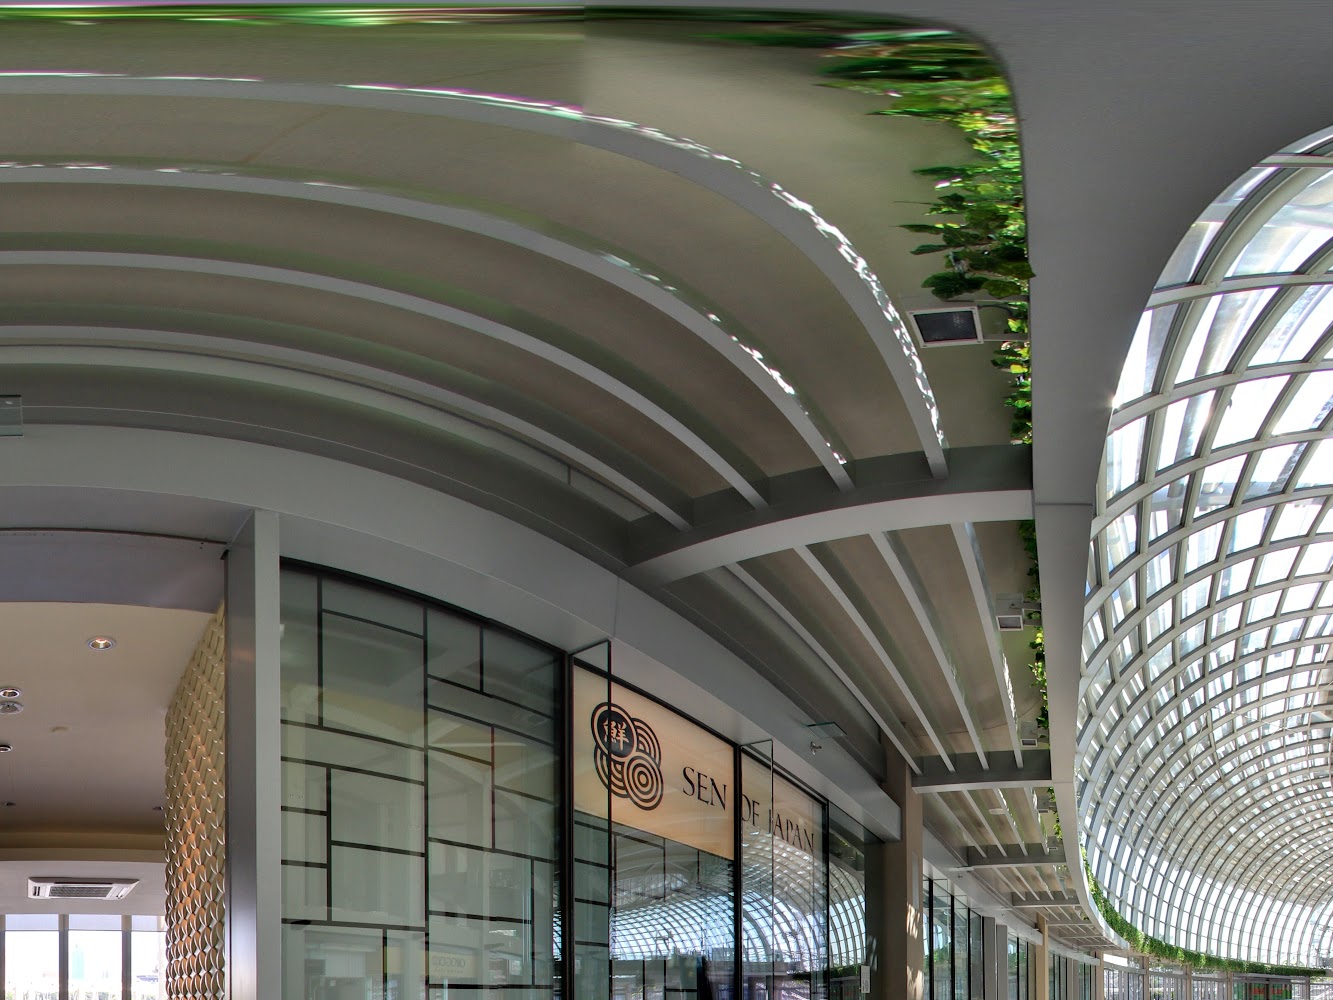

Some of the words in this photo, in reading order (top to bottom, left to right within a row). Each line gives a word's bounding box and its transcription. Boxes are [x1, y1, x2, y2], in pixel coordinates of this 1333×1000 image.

[603, 717, 629, 751] 鮮
[682, 766, 727, 811] SEN
[741, 793, 760, 826] OF
[768, 808, 815, 853] JAPAN
